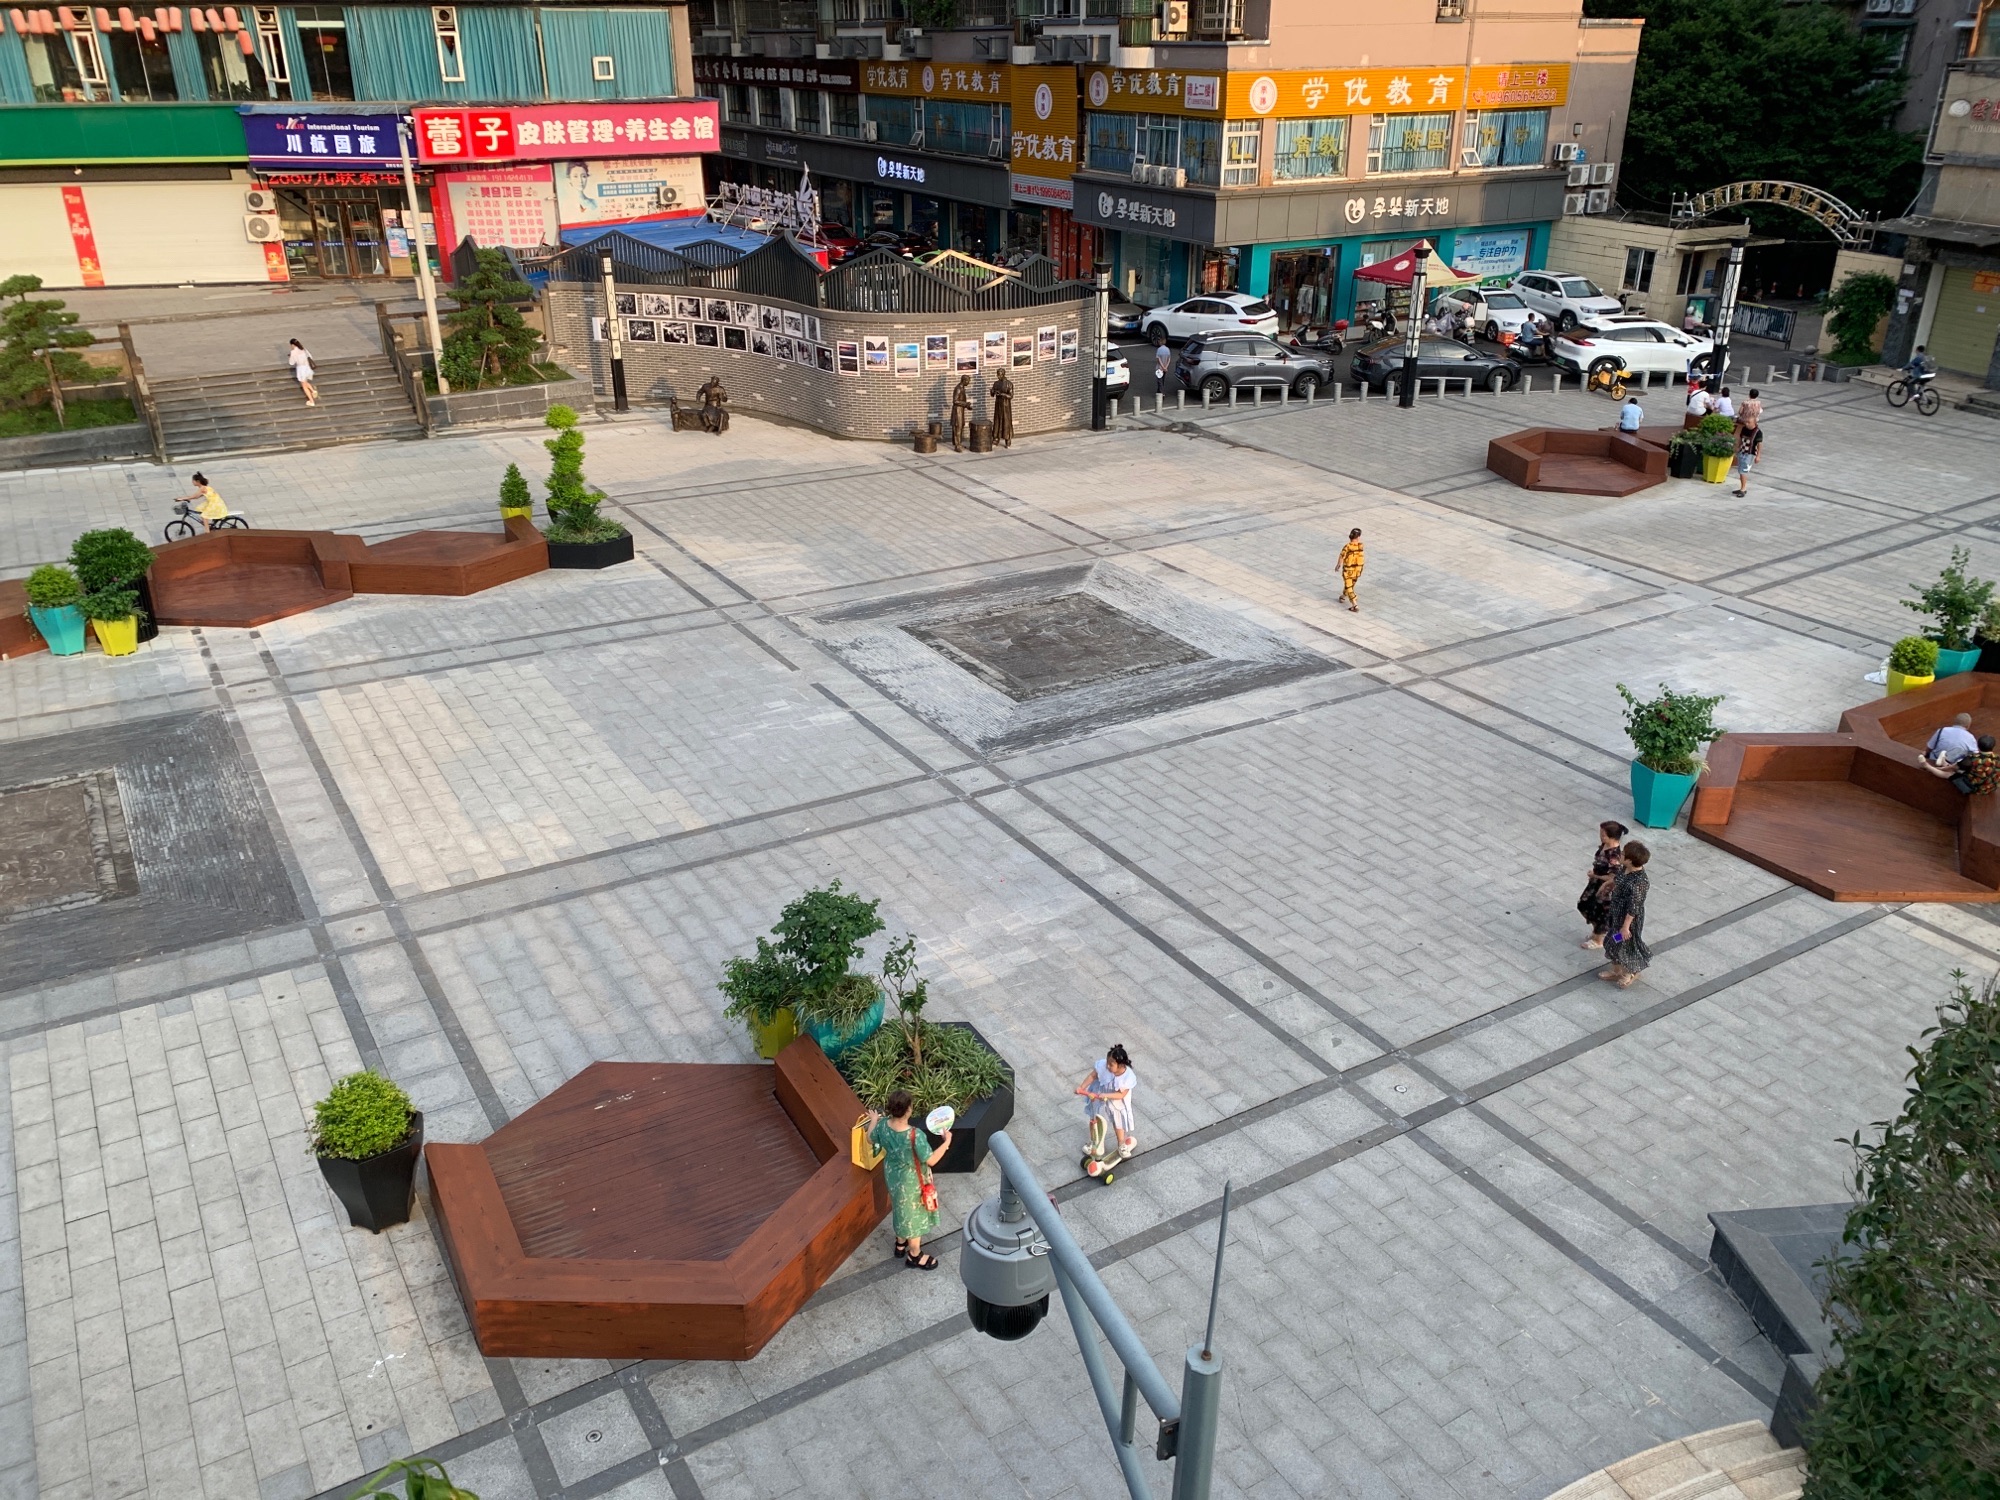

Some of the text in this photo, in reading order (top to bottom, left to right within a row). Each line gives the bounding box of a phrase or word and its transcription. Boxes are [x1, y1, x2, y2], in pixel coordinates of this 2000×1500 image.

[867, 65, 909, 88] 学优教育
[941, 68, 1001, 93] 学优教育
[1111, 71, 1182, 96] 学优教育
[1498, 69, 1548, 87] 请上二楼
[1302, 74, 1454, 109] 学优教育
[1485, 88, 1557, 103] 19960564253
[307, 123, 351, 131] International
[424, 115, 714, 155] 蕾子 皮肤管理·养生会馆
[287, 134, 376, 154] 川航国旅
[1011, 131, 1075, 163] 学优教育
[887, 161, 925, 182] 孕婴新天地
[1115, 198, 1175, 227] 孕婴新天地
[1370, 196, 1449, 218] 孕婴新天地
[1479, 246, 1517, 258] 专注自护力
